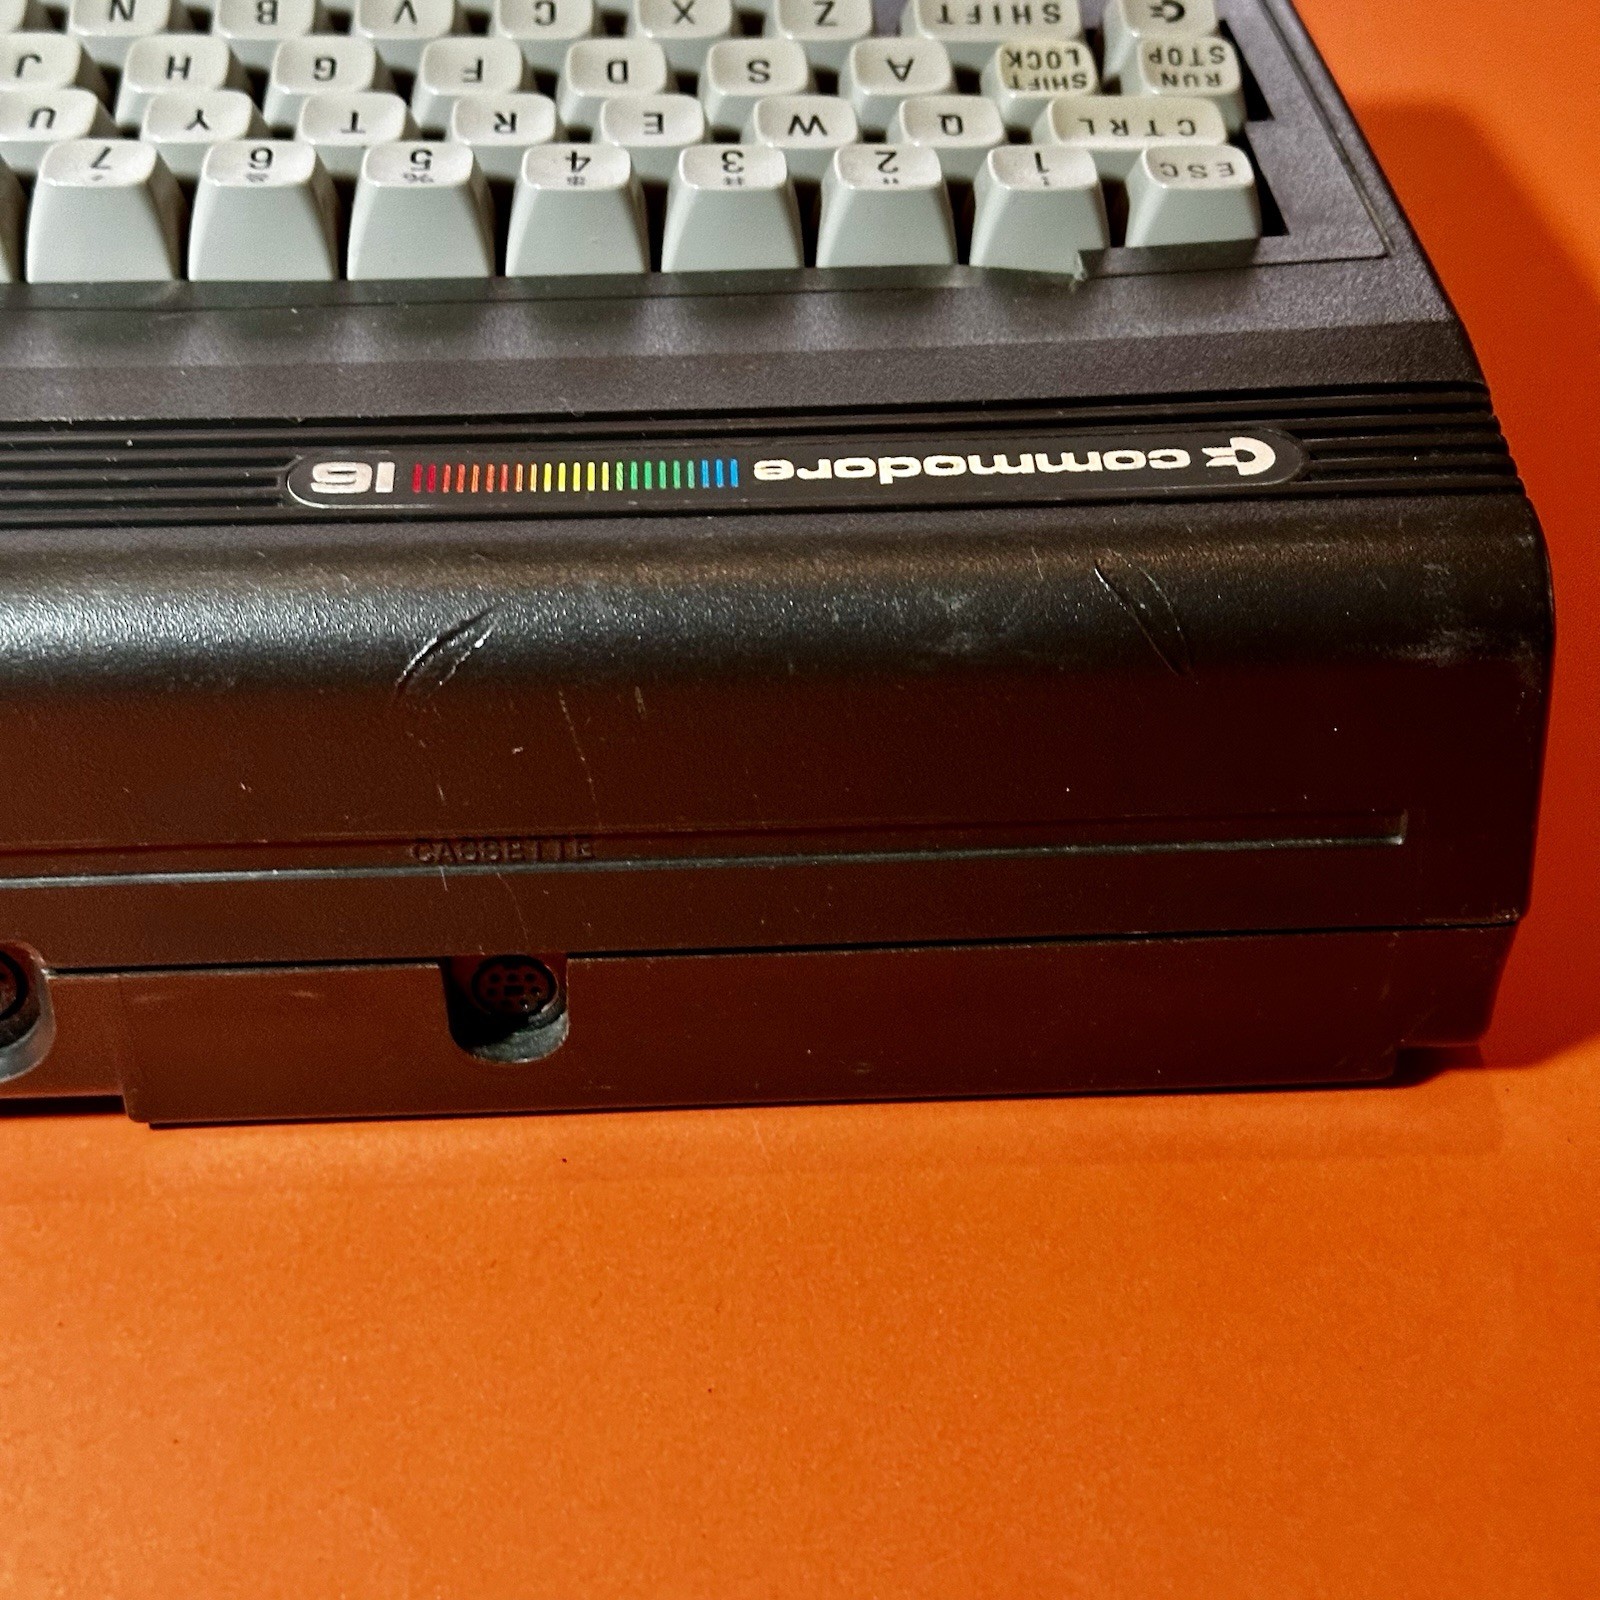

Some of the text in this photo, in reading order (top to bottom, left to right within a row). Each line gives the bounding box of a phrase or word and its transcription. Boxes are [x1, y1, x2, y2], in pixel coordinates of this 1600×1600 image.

[109, 0, 136, 22] N
[257, 0, 278, 25] B
[393, 0, 418, 25] V
[534, 0, 558, 26] C
[673, 0, 696, 25] X
[814, 1, 838, 27] Z
[937, 3, 1061, 26] SHIFT
[14, 53, 42, 78] J
[166, 55, 191, 80] H
[1007, 48, 1081, 70] LOCK
[1149, 46, 1226, 67] STOP
[313, 56, 337, 82] G
[461, 57, 483, 83] F
[606, 59, 629, 84] D
[746, 59, 771, 84] S
[886, 58, 914, 82] A
[1161, 72, 1222, 88] RUN
[1011, 72, 1088, 91] SHIFT
[28, 106, 56, 129] U
[186, 109, 210, 131] Y
[340, 110, 366, 134] T
[493, 111, 517, 134] R
[643, 111, 664, 135] E
[788, 114, 828, 136] W
[937, 114, 964, 136] Q
[1078, 118, 1196, 137] CTRL
[90, 146, 112, 170] 7
[250, 147, 274, 170] 6
[409, 149, 433, 171] 5
[565, 151, 591, 173] 4
[721, 151, 745, 174] 3
[875, 151, 899, 174] 2
[1034, 152, 1050, 174] 1
[1159, 161, 1236, 178] ESC
[753, 447, 1191, 484] commodore
[311, 461, 396, 494] 16
[409, 836, 596, 862] CASSETTE
